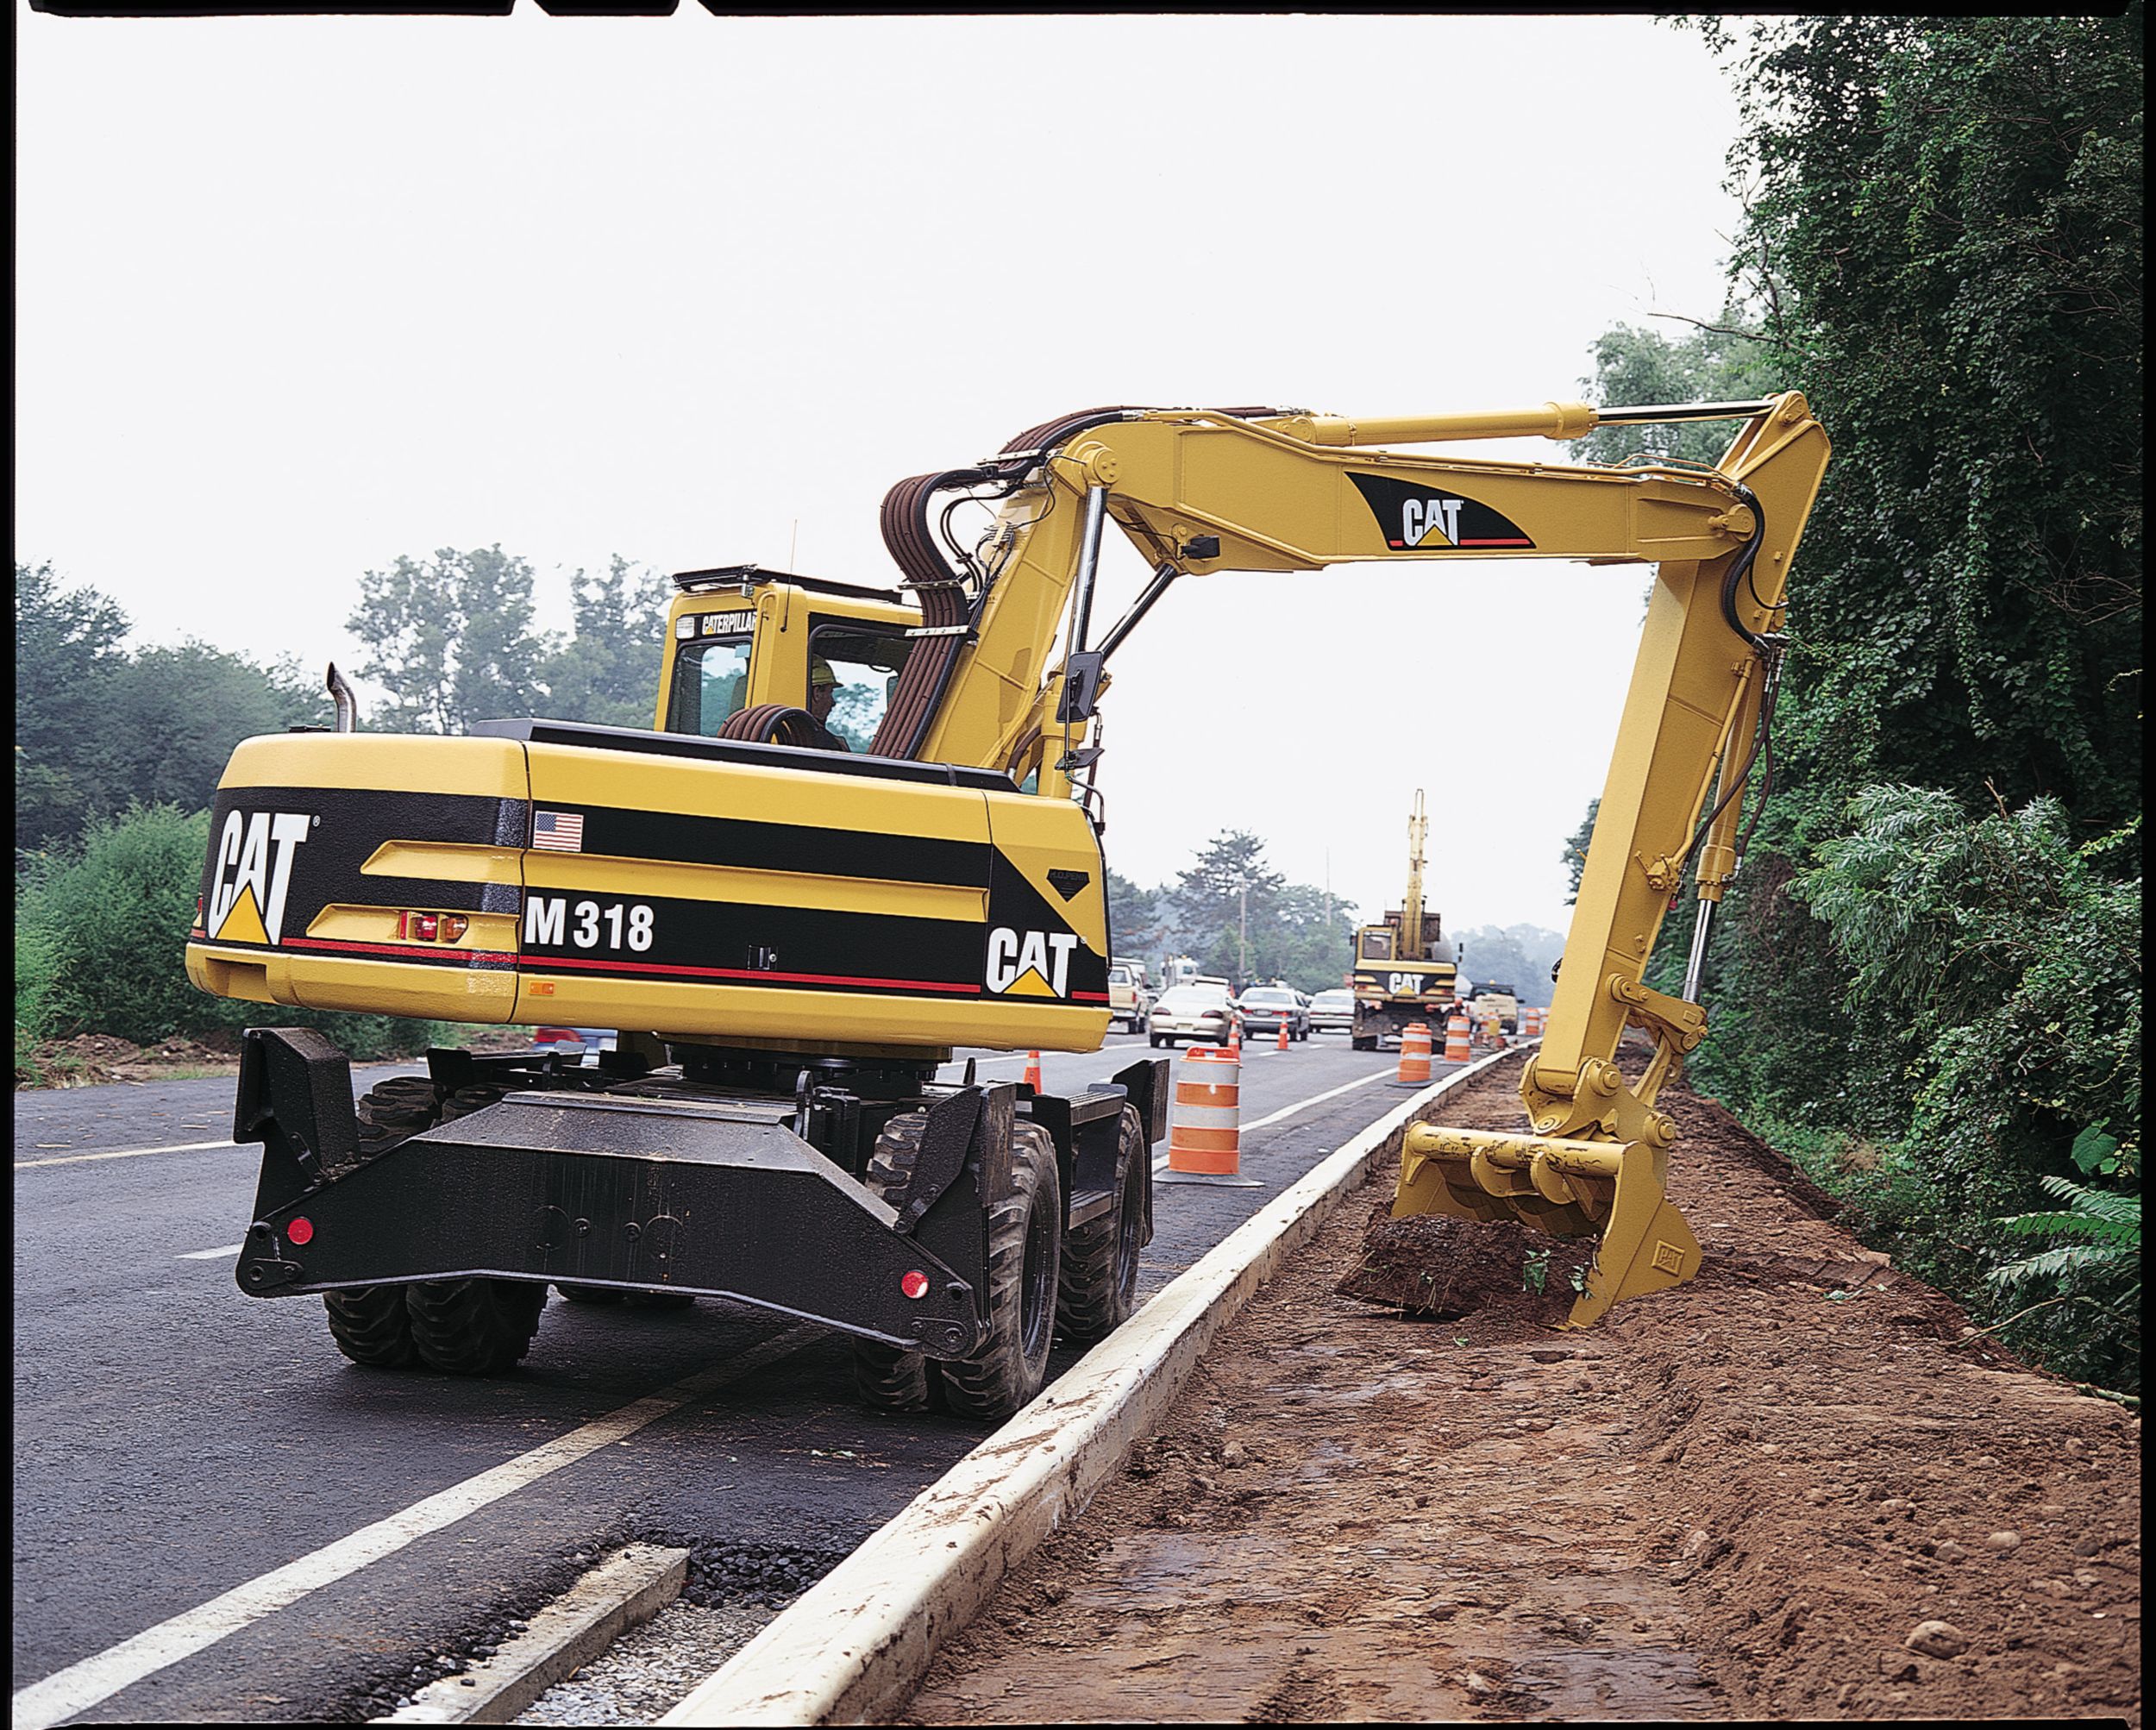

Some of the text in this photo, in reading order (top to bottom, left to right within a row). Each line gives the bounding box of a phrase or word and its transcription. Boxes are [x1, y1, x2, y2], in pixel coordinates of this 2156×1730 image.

[1402, 498, 1462, 546] CAT
[208, 810, 311, 945] CAT
[524, 896, 655, 952] M 318
[986, 927, 1078, 999] CAT
[1388, 972, 1424, 995] CAT
